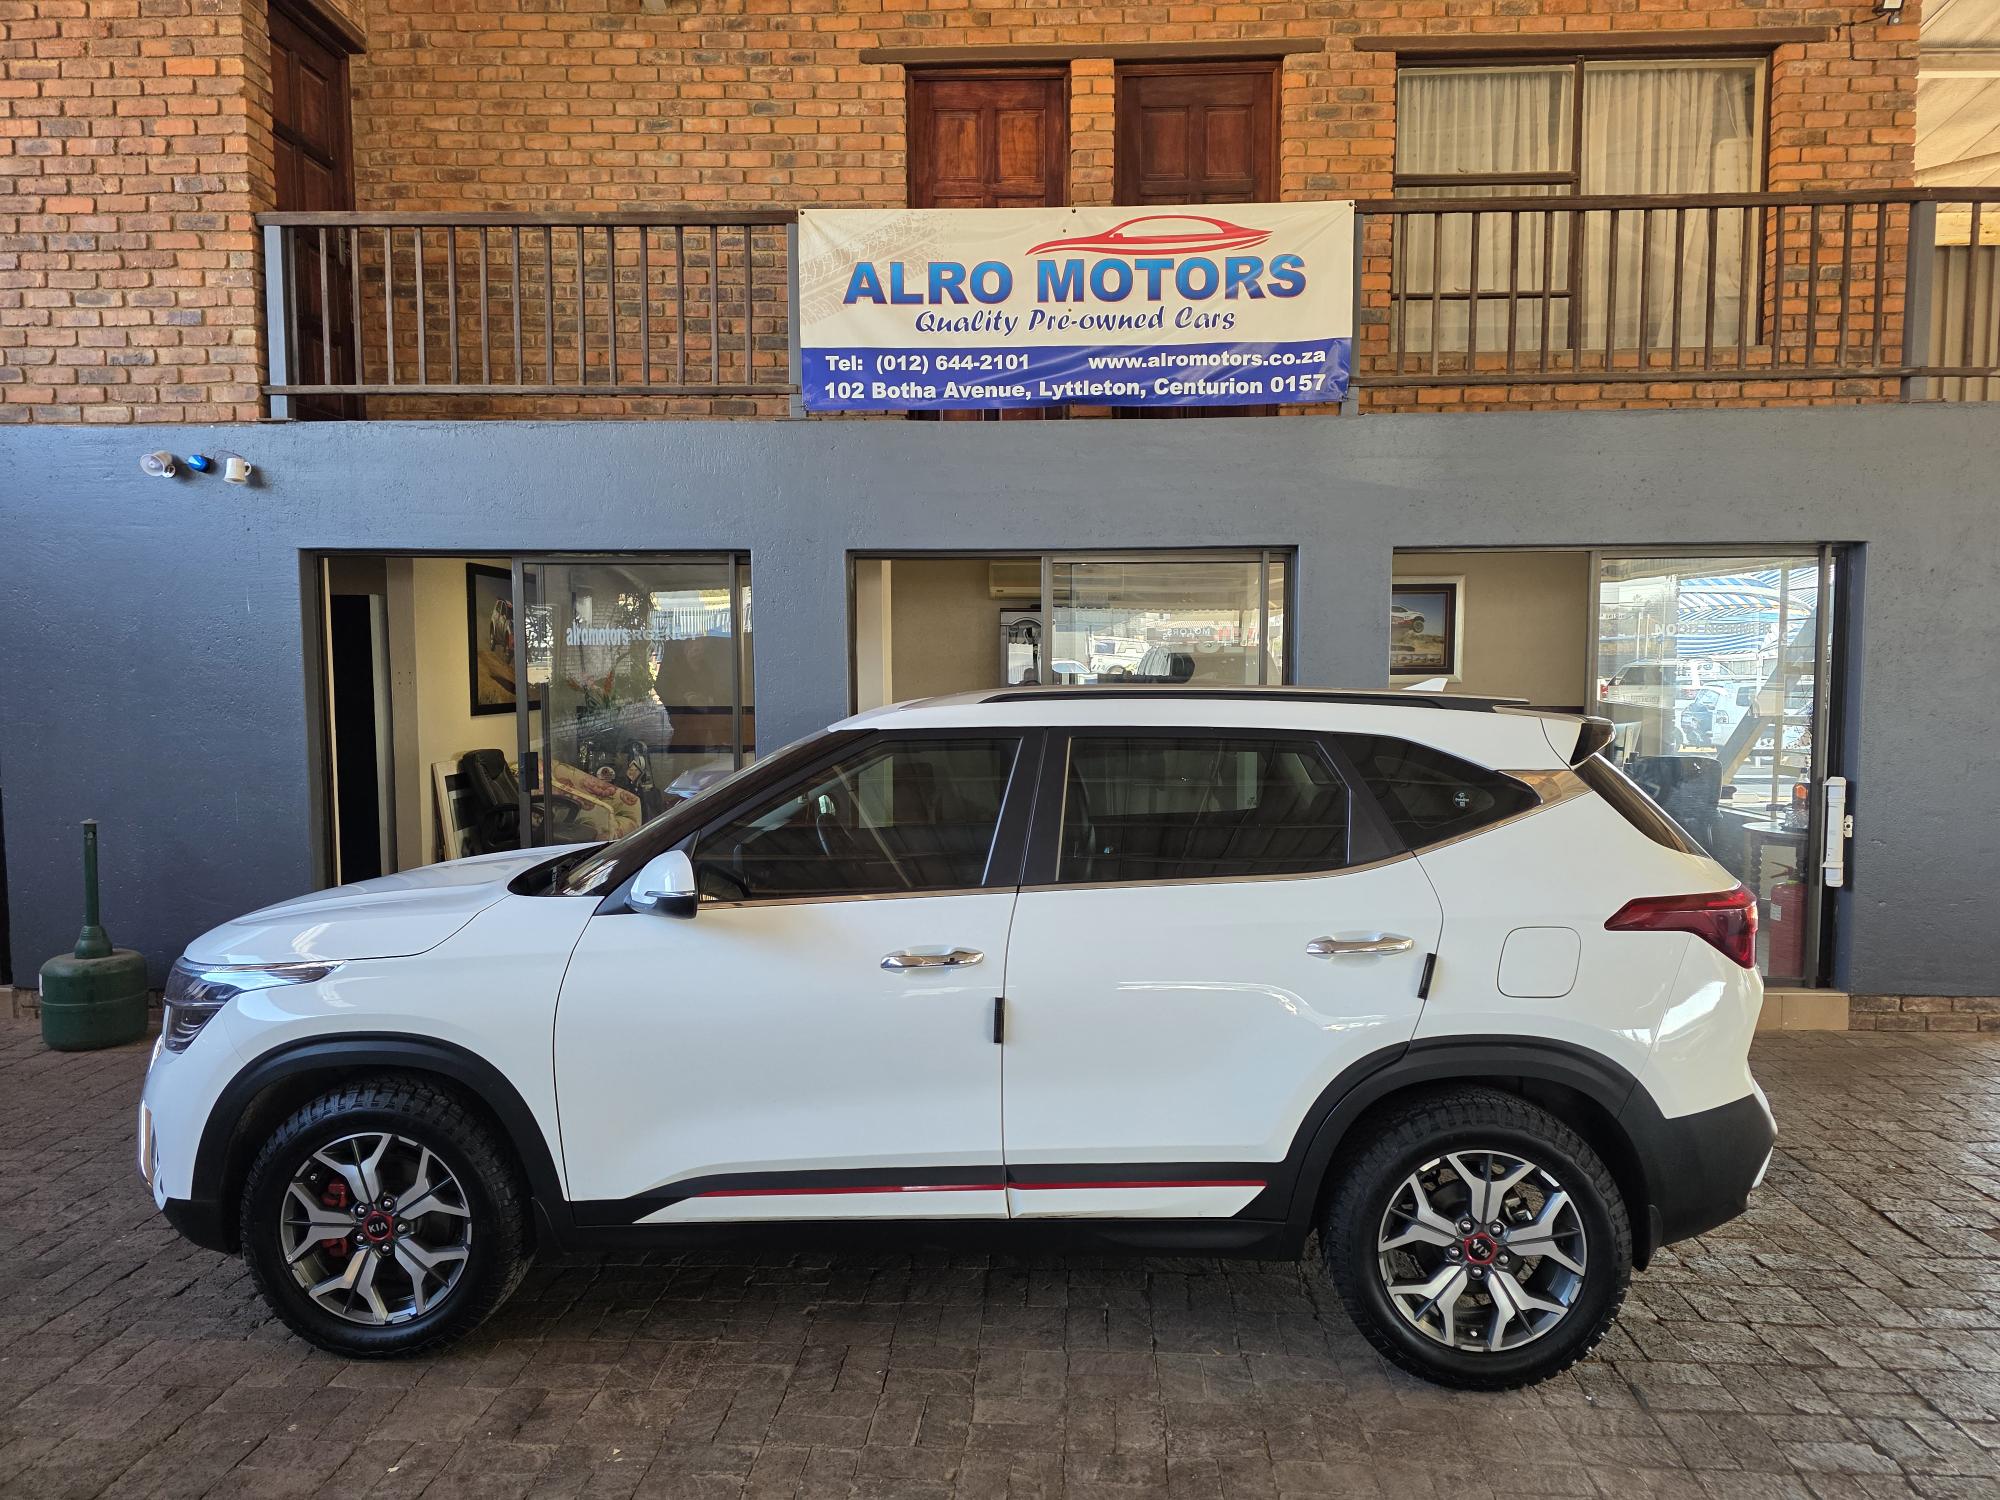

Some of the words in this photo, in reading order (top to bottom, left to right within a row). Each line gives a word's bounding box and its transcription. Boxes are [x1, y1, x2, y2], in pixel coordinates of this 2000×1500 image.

[842, 260, 1013, 305] ALRO
[1036, 253, 1307, 304] MOTORS
[915, 309, 1018, 336] Quality
[1028, 305, 1165, 332] Pre-owned
[1174, 306, 1236, 330] Cars
[825, 355, 863, 371] Tel:
[876, 355, 929, 374] (012)
[935, 353, 1029, 371] 644-2101
[1088, 349, 1326, 369] www.alromotors.co.za
[824, 382, 865, 399] 102
[872, 381, 936, 399] Botha
[943, 381, 1031, 401] Avenue,
[1039, 379, 1146, 401] Lyttleton,
[1153, 377, 1263, 396] Centurion
[1270, 373, 1326, 393] 0157
[566, 622, 631, 646] alromotors
[368, 1222, 388, 1233] KIA
[1472, 1238, 1491, 1258] KIA
